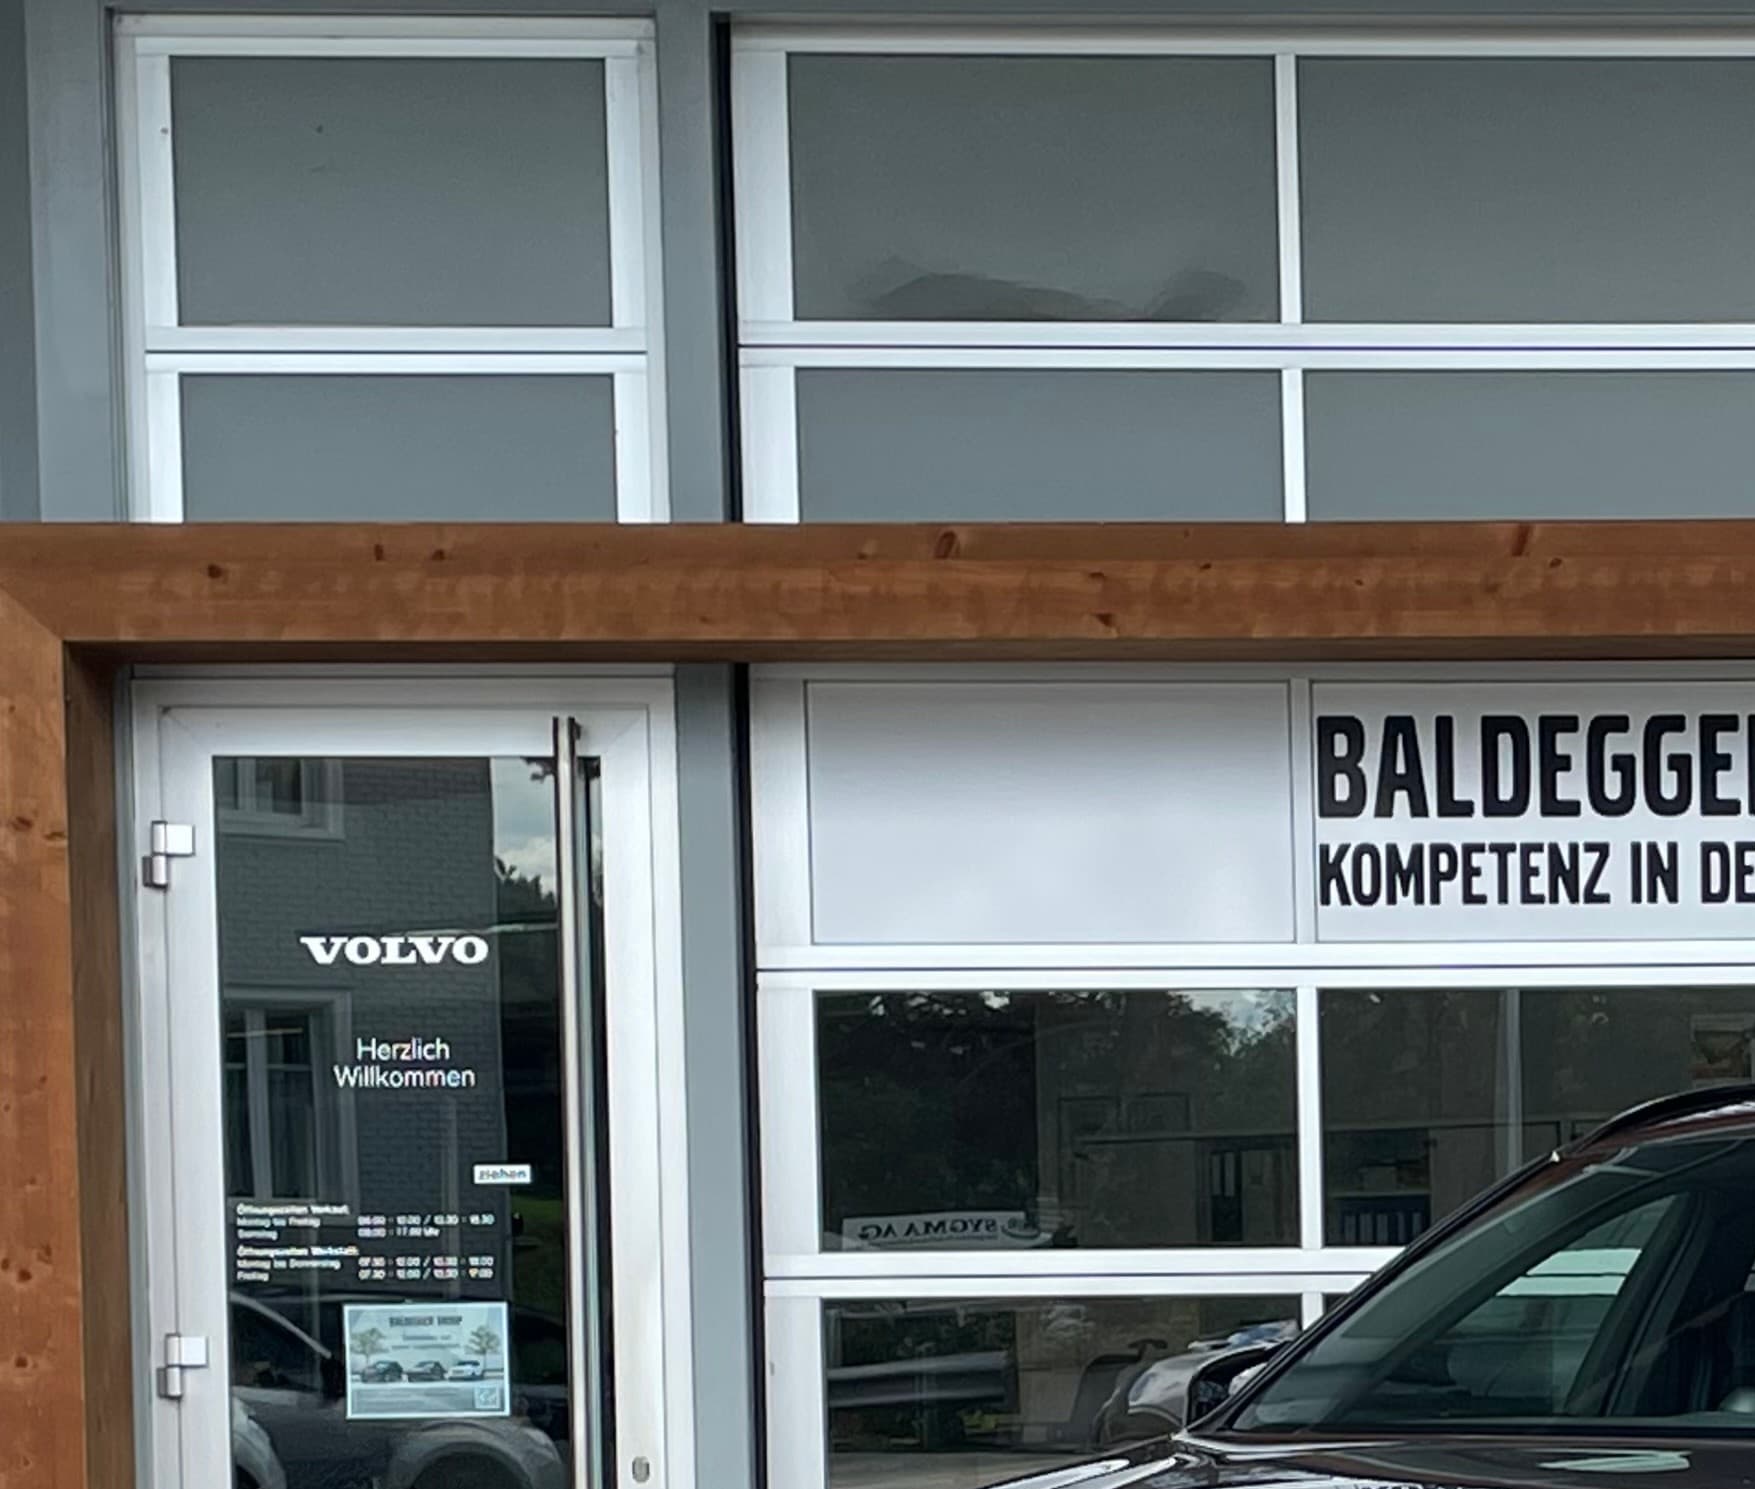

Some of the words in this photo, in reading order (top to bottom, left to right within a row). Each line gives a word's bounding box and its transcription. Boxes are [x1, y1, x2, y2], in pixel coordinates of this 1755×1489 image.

[1318, 841, 1612, 906] KOMPETENZ
[1630, 841, 1679, 904] IN
[300, 936, 489, 965] VOLVO
[356, 1037, 450, 1062] Herzlich
[333, 1065, 476, 1088] Willkommen
